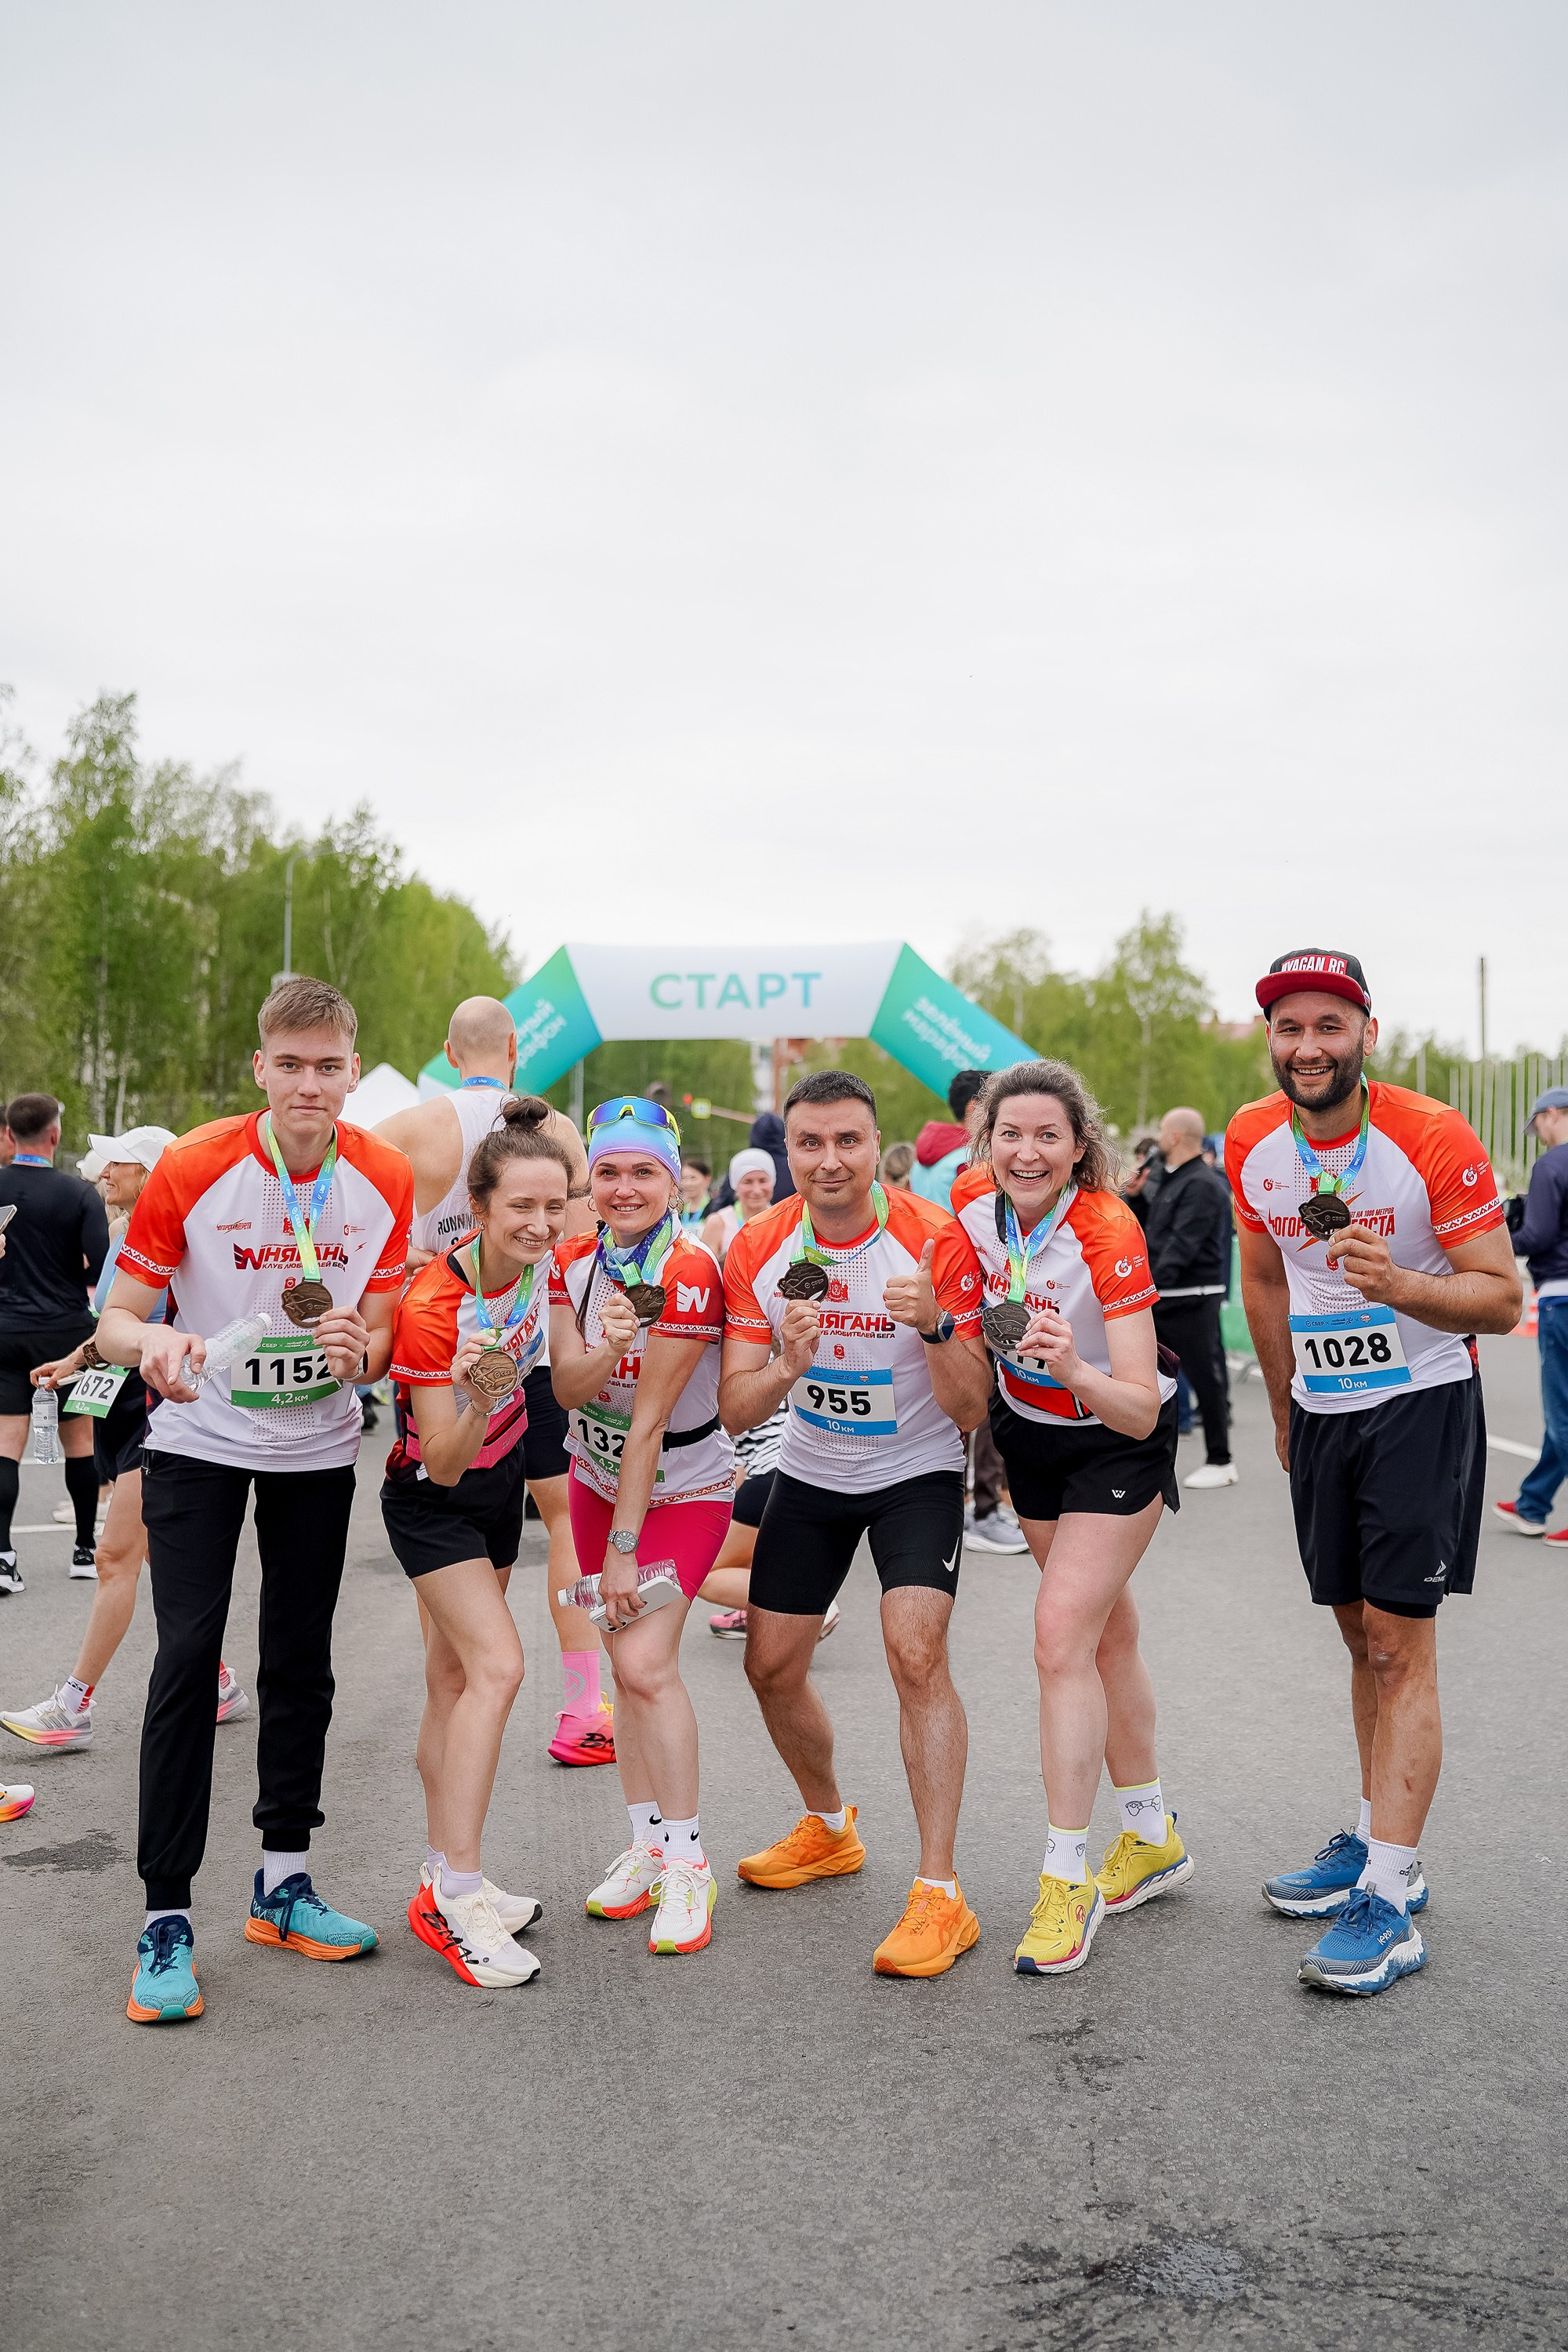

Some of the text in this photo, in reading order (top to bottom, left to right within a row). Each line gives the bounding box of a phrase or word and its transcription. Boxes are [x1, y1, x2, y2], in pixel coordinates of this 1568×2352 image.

[649, 972, 822, 1010] СТАРТ
[1375, 1207, 1395, 1216] МЕТРОВ
[829, 1330, 875, 1339] ЛЮБИТЕЛЕЙ
[1305, 1333, 1392, 1368] 1028
[245, 1352, 333, 1386] 1152
[807, 1385, 871, 1415] 955
[577, 1417, 626, 1459] 132
